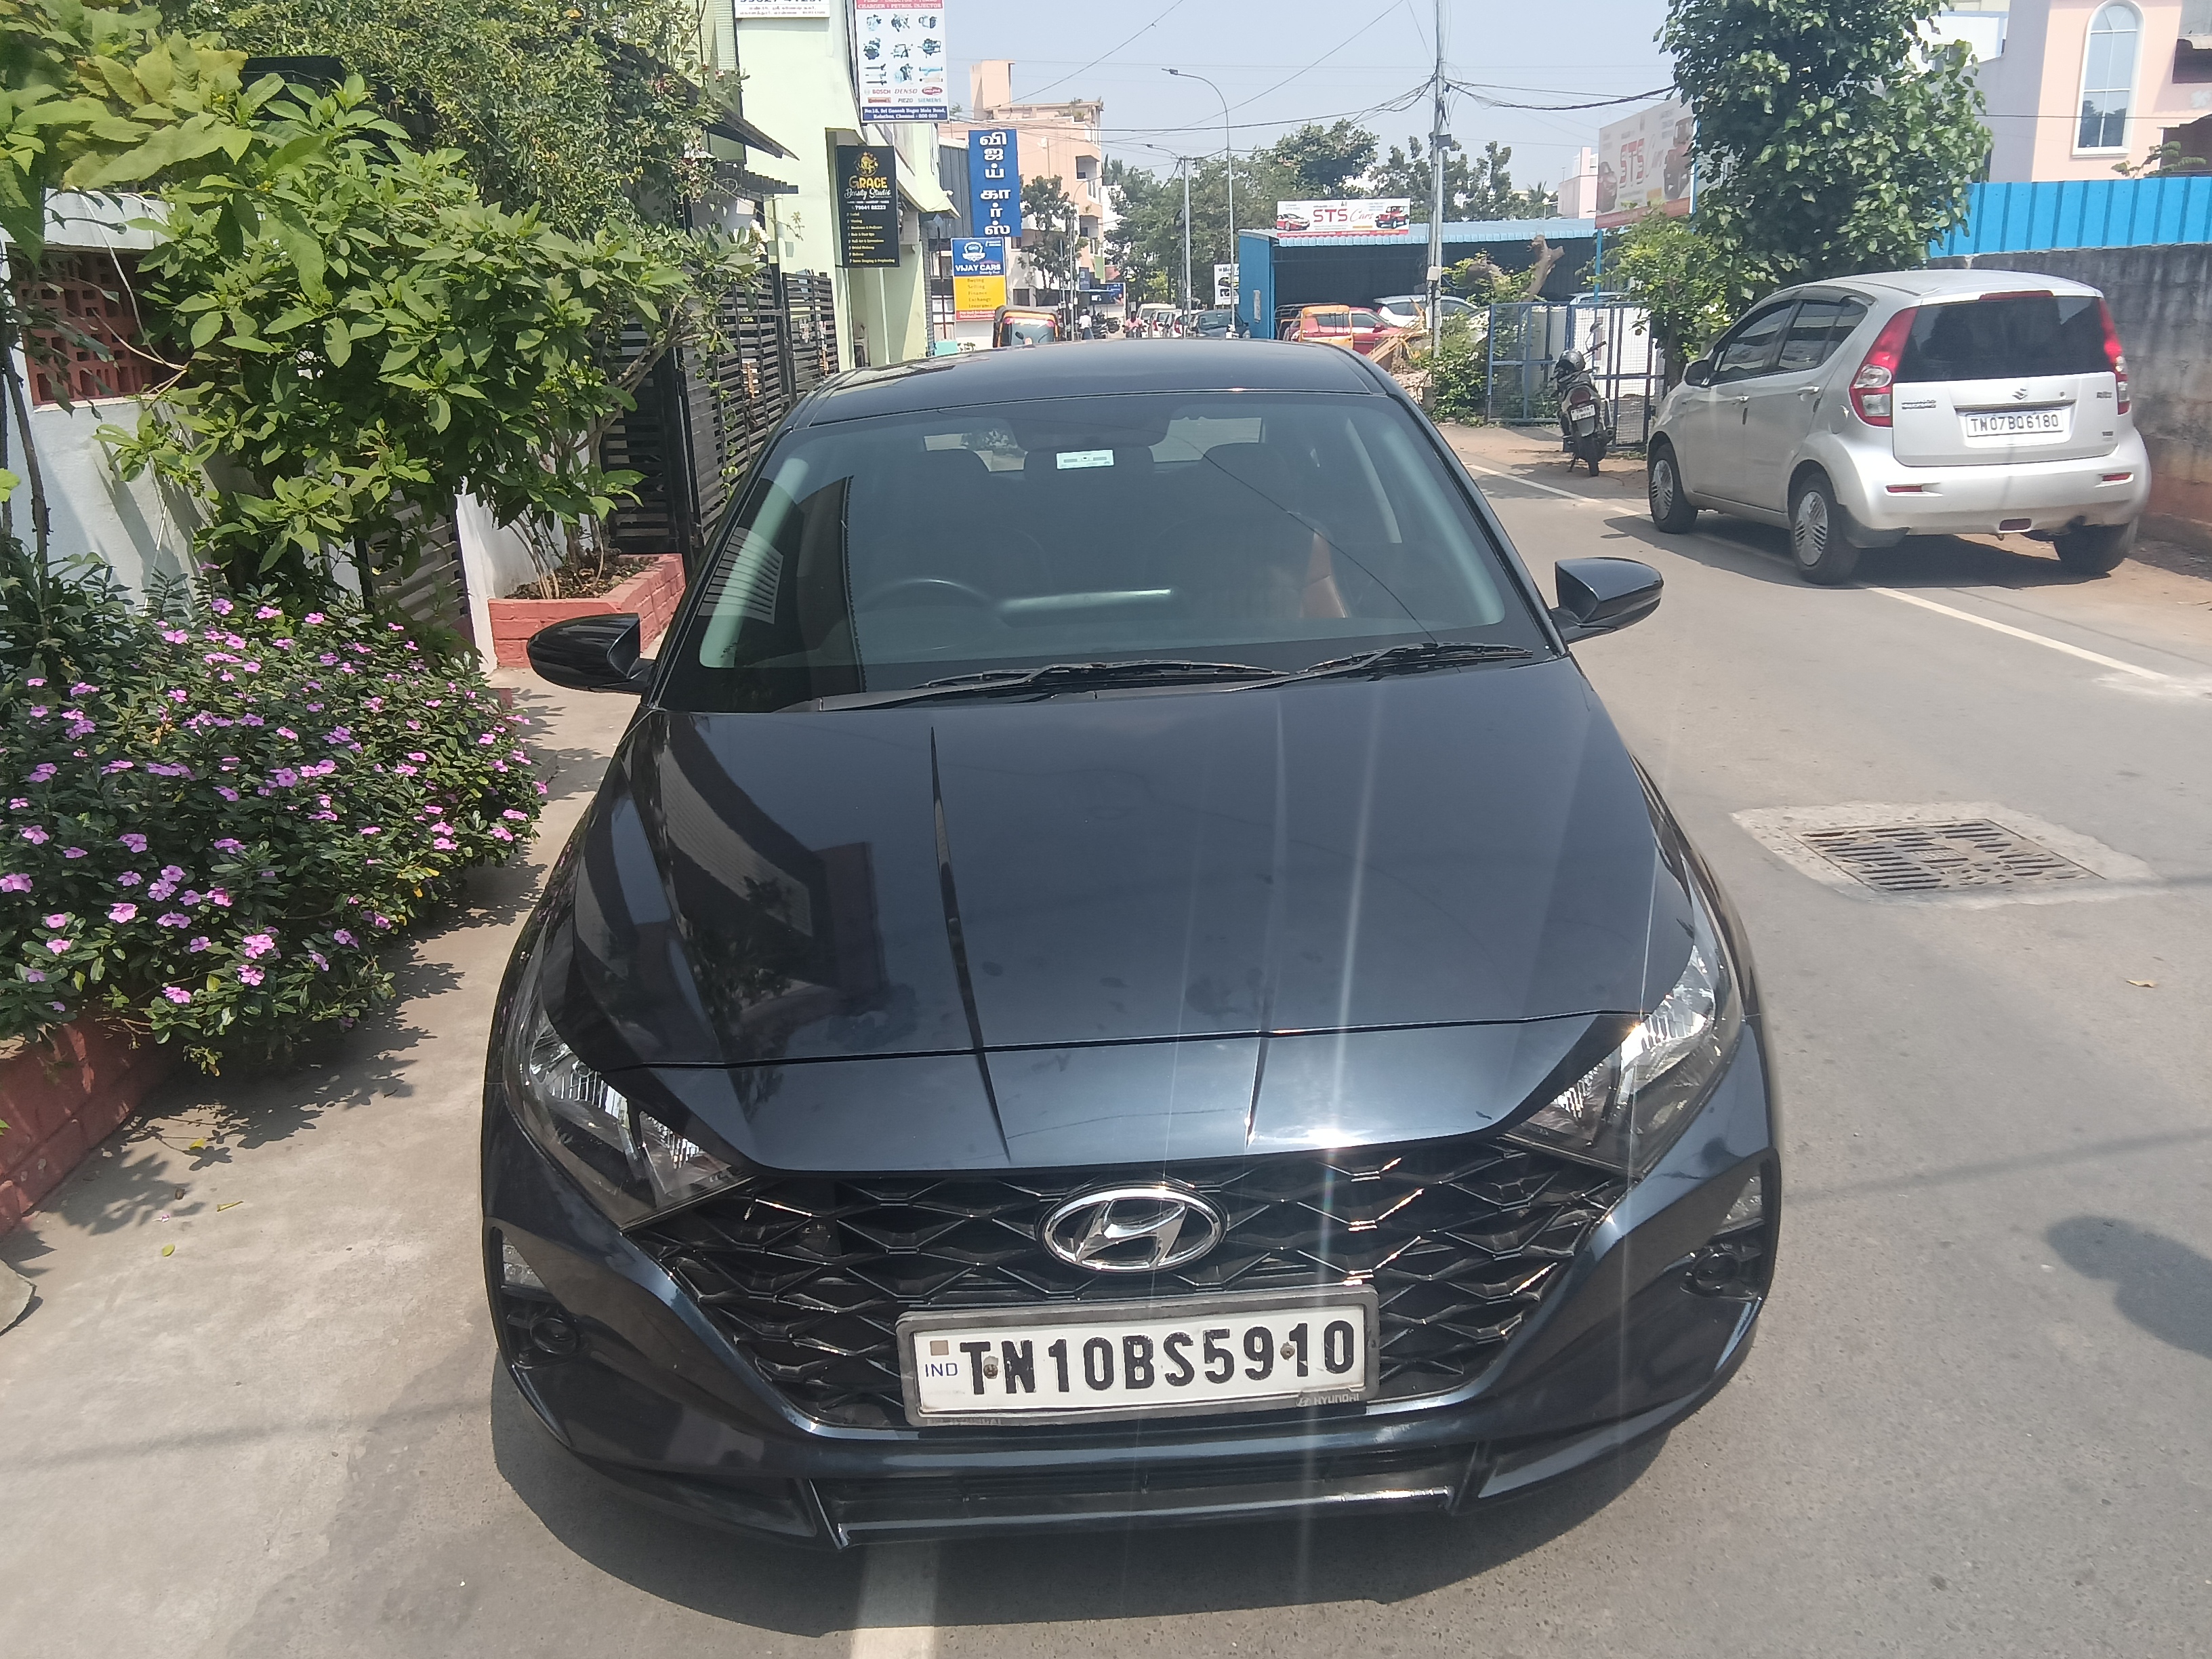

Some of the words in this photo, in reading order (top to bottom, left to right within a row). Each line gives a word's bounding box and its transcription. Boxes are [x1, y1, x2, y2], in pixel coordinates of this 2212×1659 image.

[1619, 138, 1645, 184] STS
[848, 176, 888, 189] GRACE
[844, 188, 867, 200] Beauty
[869, 188, 892, 199] Studio
[1313, 209, 1348, 223] STS
[1350, 209, 1374, 222] Cars
[960, 1319, 1355, 1395] TN10BS5910
[924, 1362, 958, 1378] IND
[1313, 1393, 1359, 1406] HYUNDAI
